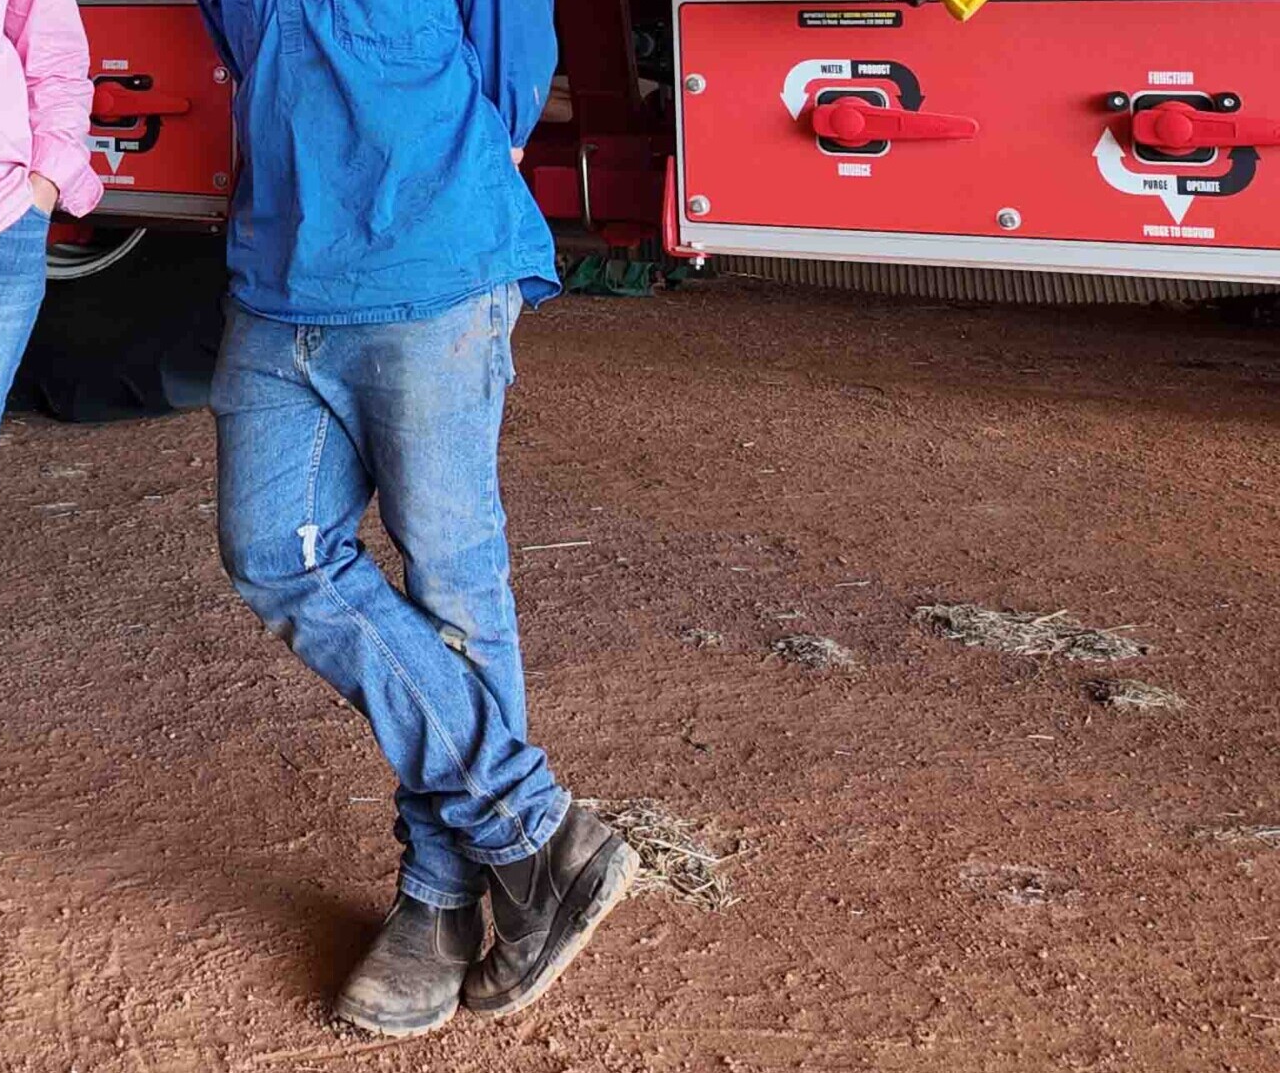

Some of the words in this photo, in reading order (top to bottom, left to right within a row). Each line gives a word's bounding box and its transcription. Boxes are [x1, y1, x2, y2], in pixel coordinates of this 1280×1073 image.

[820, 64, 843, 74] WATER
[858, 64, 891, 75] PRODUCT
[1143, 179, 1168, 190] PURGE
[1186, 180, 1221, 192] OPERATE
